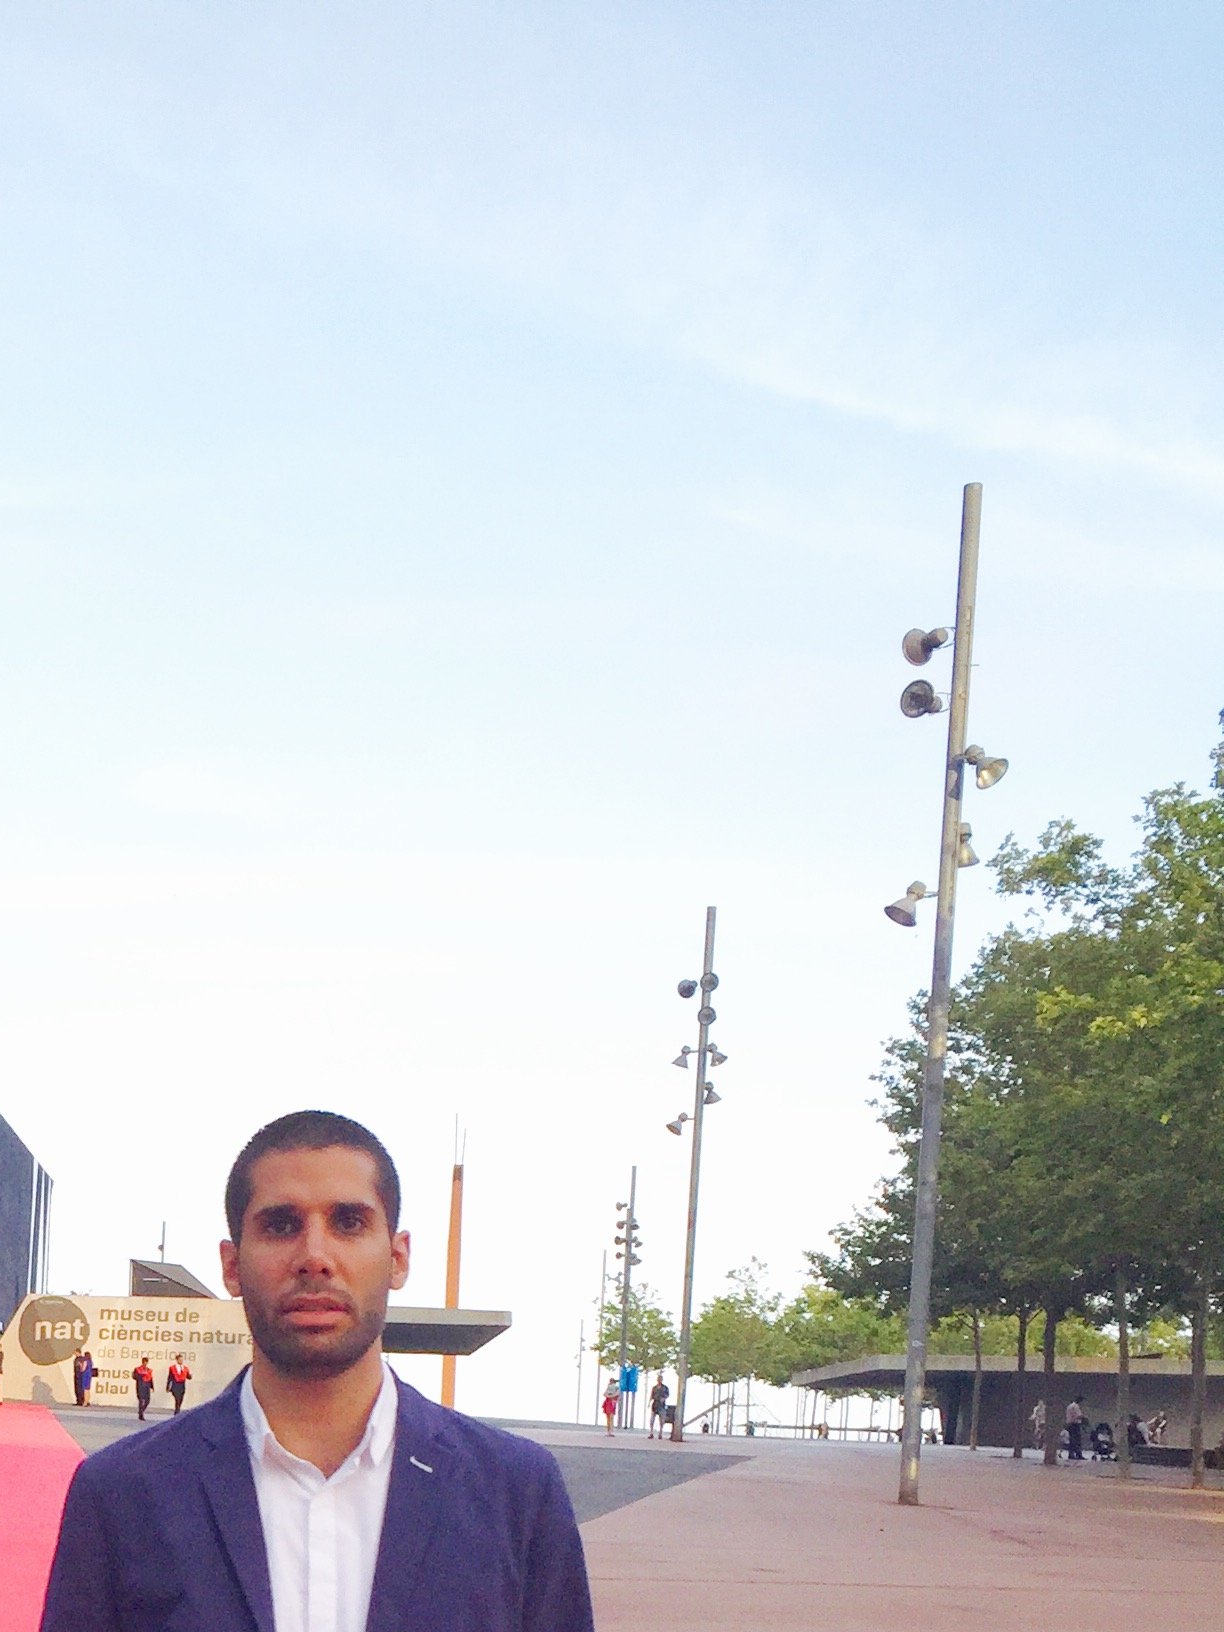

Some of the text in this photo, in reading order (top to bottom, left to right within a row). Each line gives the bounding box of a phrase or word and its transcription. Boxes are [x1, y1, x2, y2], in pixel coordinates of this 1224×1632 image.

[100, 1308, 200, 1323] museu de
[35, 1319, 85, 1341] nat
[98, 1325, 253, 1345] ciències natura
[97, 1346, 196, 1361] de Barcelona
[98, 1369, 131, 1379] mus
[96, 1381, 129, 1395] blau
